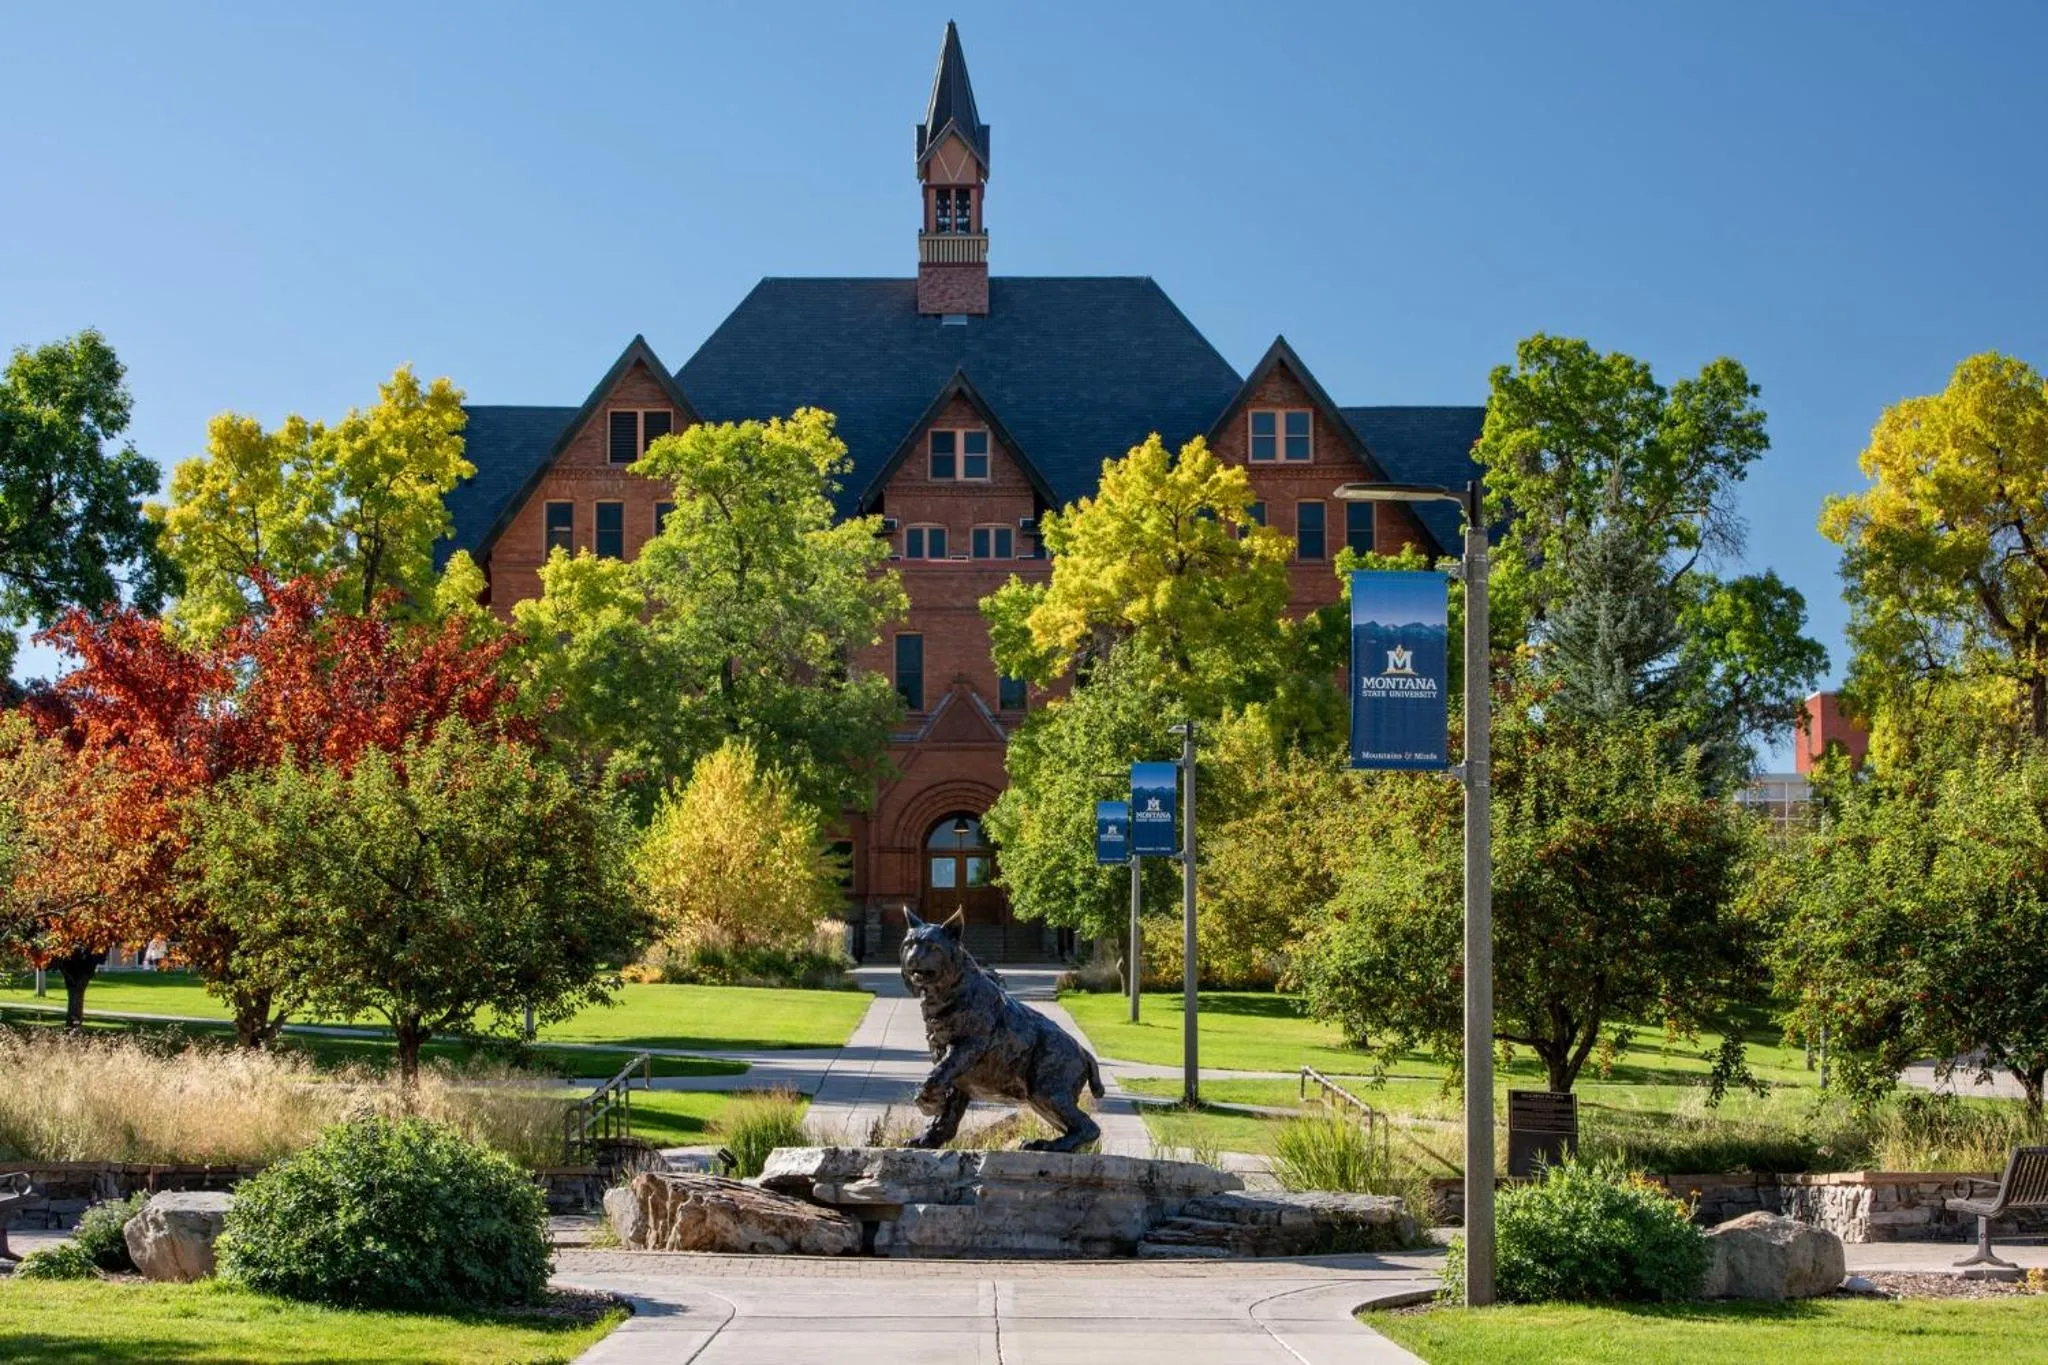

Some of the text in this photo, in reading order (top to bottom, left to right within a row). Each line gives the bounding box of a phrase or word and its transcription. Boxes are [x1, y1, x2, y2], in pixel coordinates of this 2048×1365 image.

[1362, 677, 1437, 690] MONTANA
[1389, 690, 1437, 698] UNIVERSITY
[1362, 751, 1402, 760] Mountains
[1414, 752, 1437, 760] Minds
